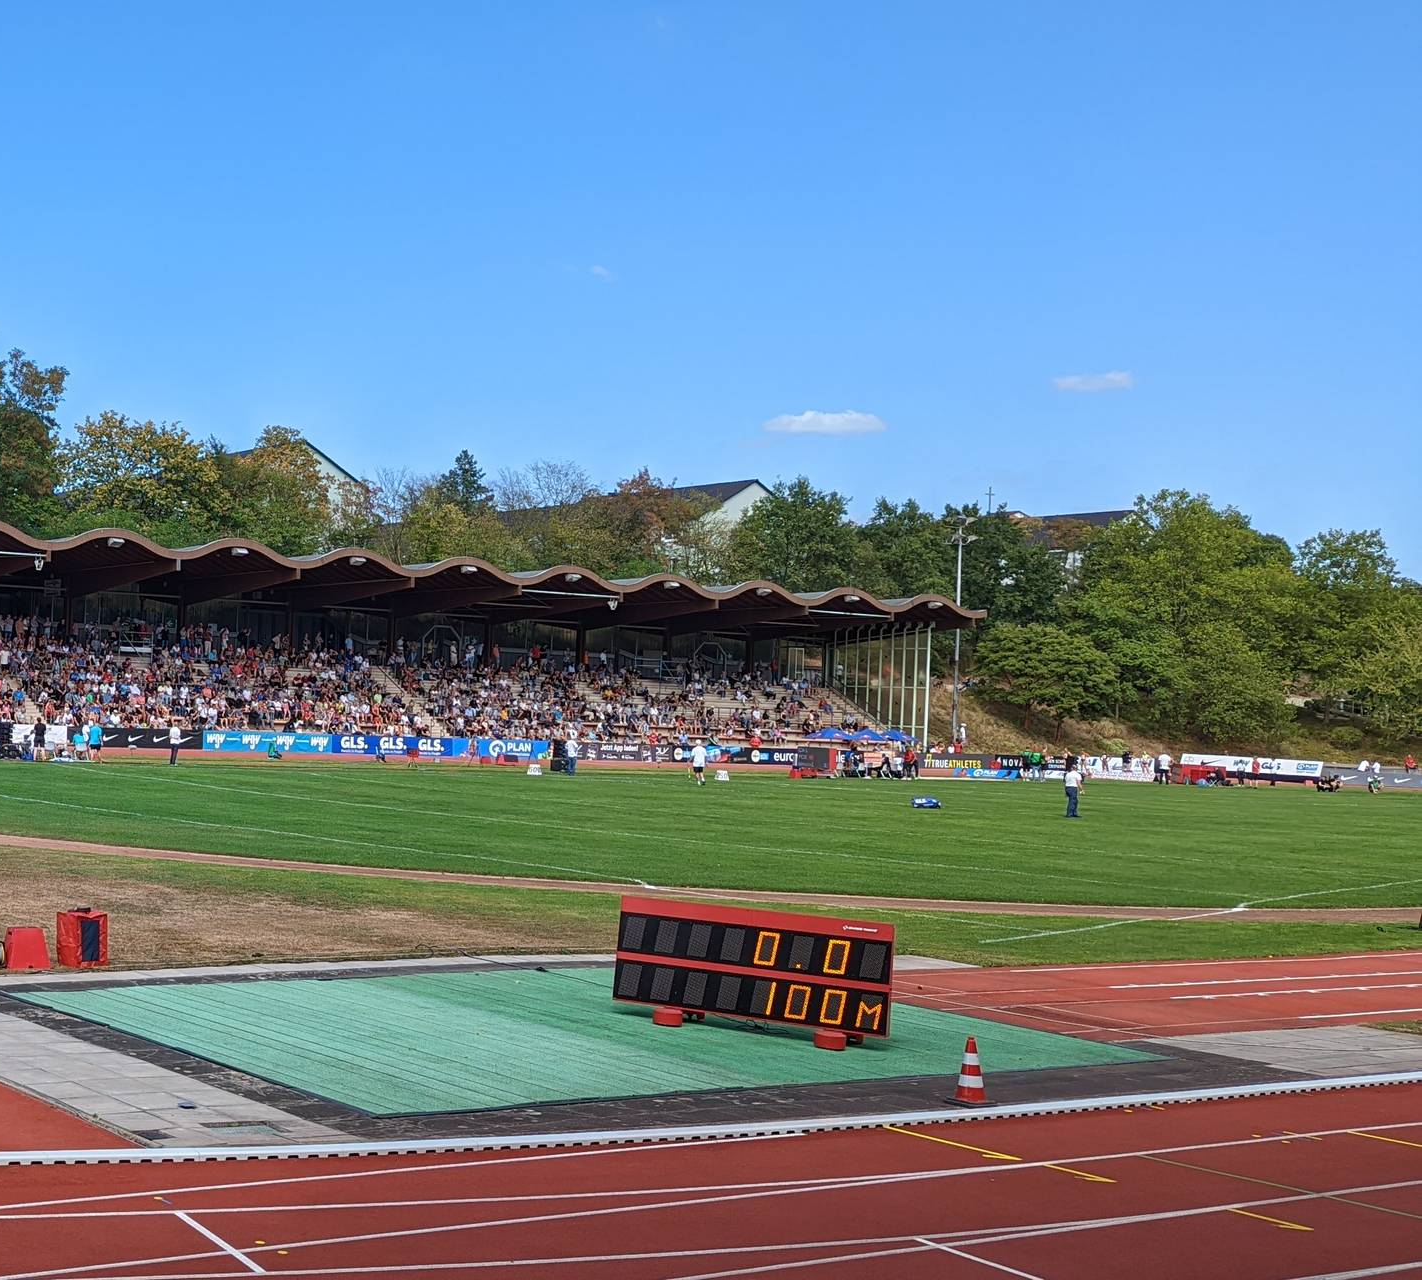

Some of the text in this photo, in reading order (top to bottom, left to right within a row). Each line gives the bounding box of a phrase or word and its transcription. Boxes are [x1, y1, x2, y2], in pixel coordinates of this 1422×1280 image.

[340, 736, 369, 749] GLS.
[379, 737, 407, 750] GLS.
[418, 738, 445, 751] GLS.
[507, 742, 532, 752] PLAN
